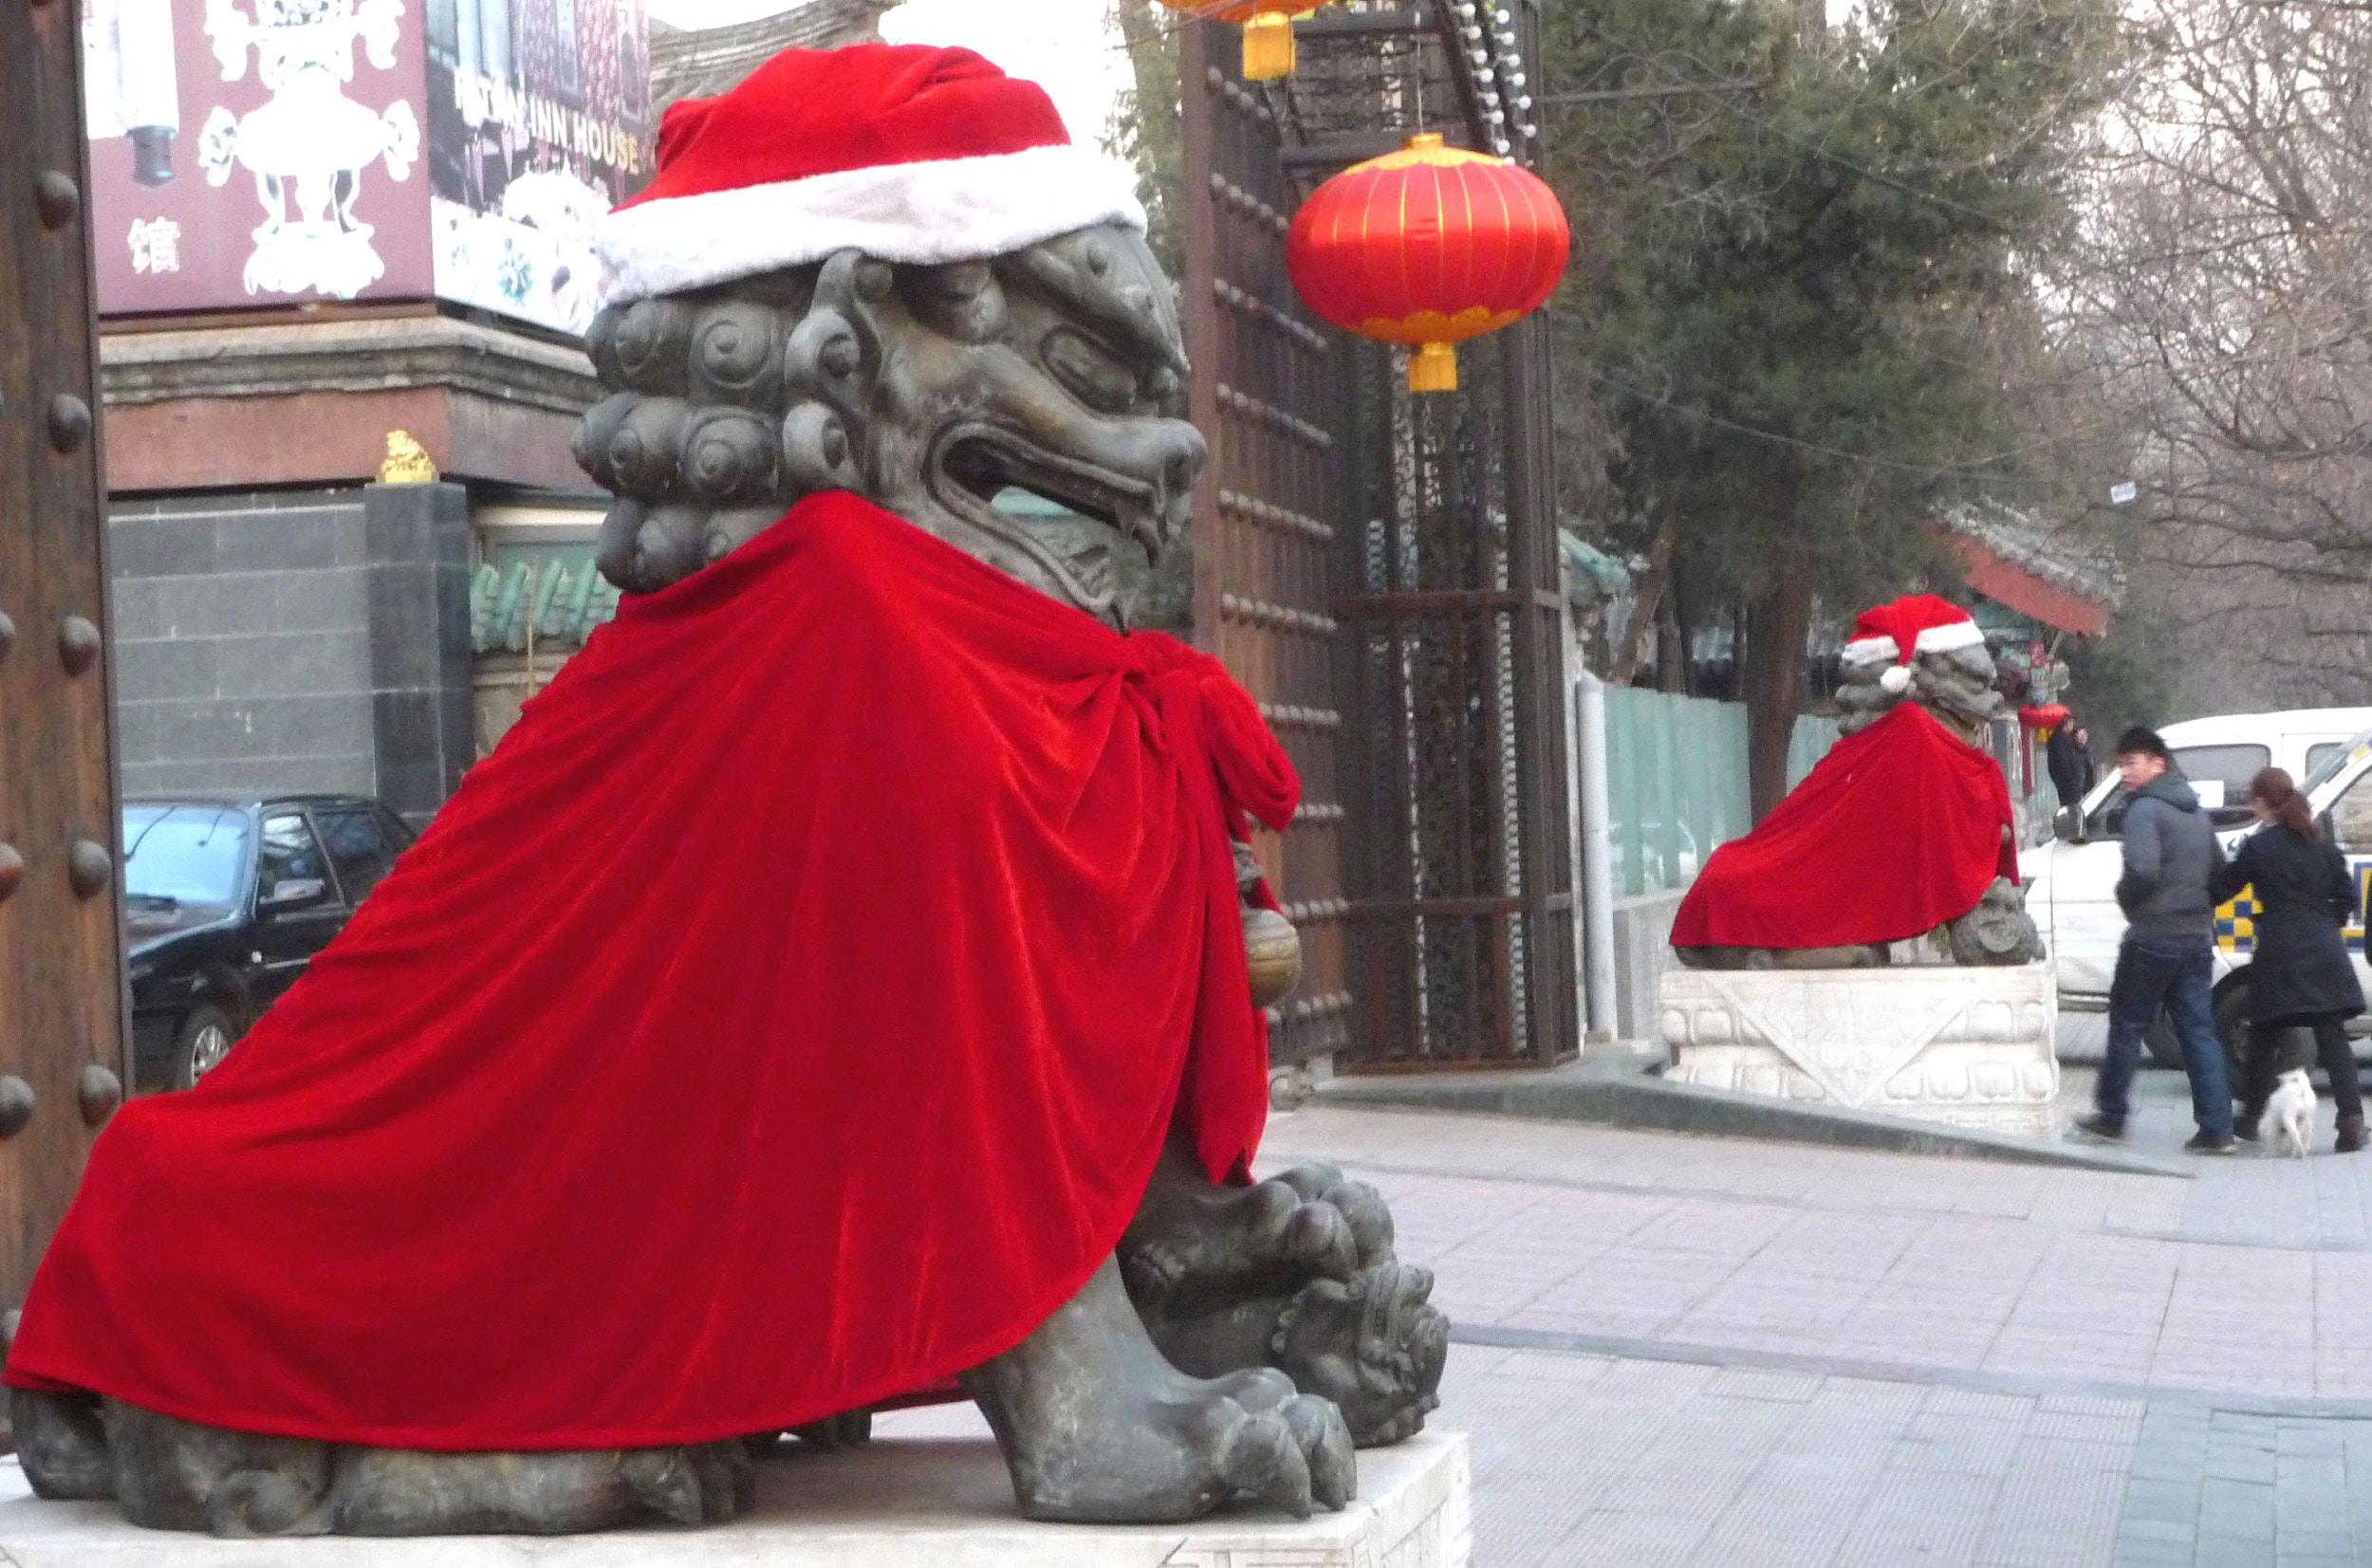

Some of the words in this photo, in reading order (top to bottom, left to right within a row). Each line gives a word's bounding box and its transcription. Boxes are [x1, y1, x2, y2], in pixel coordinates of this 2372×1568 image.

[530, 95, 567, 148] INN
[573, 110, 639, 175] HOUSE
[127, 215, 181, 274] 馆
